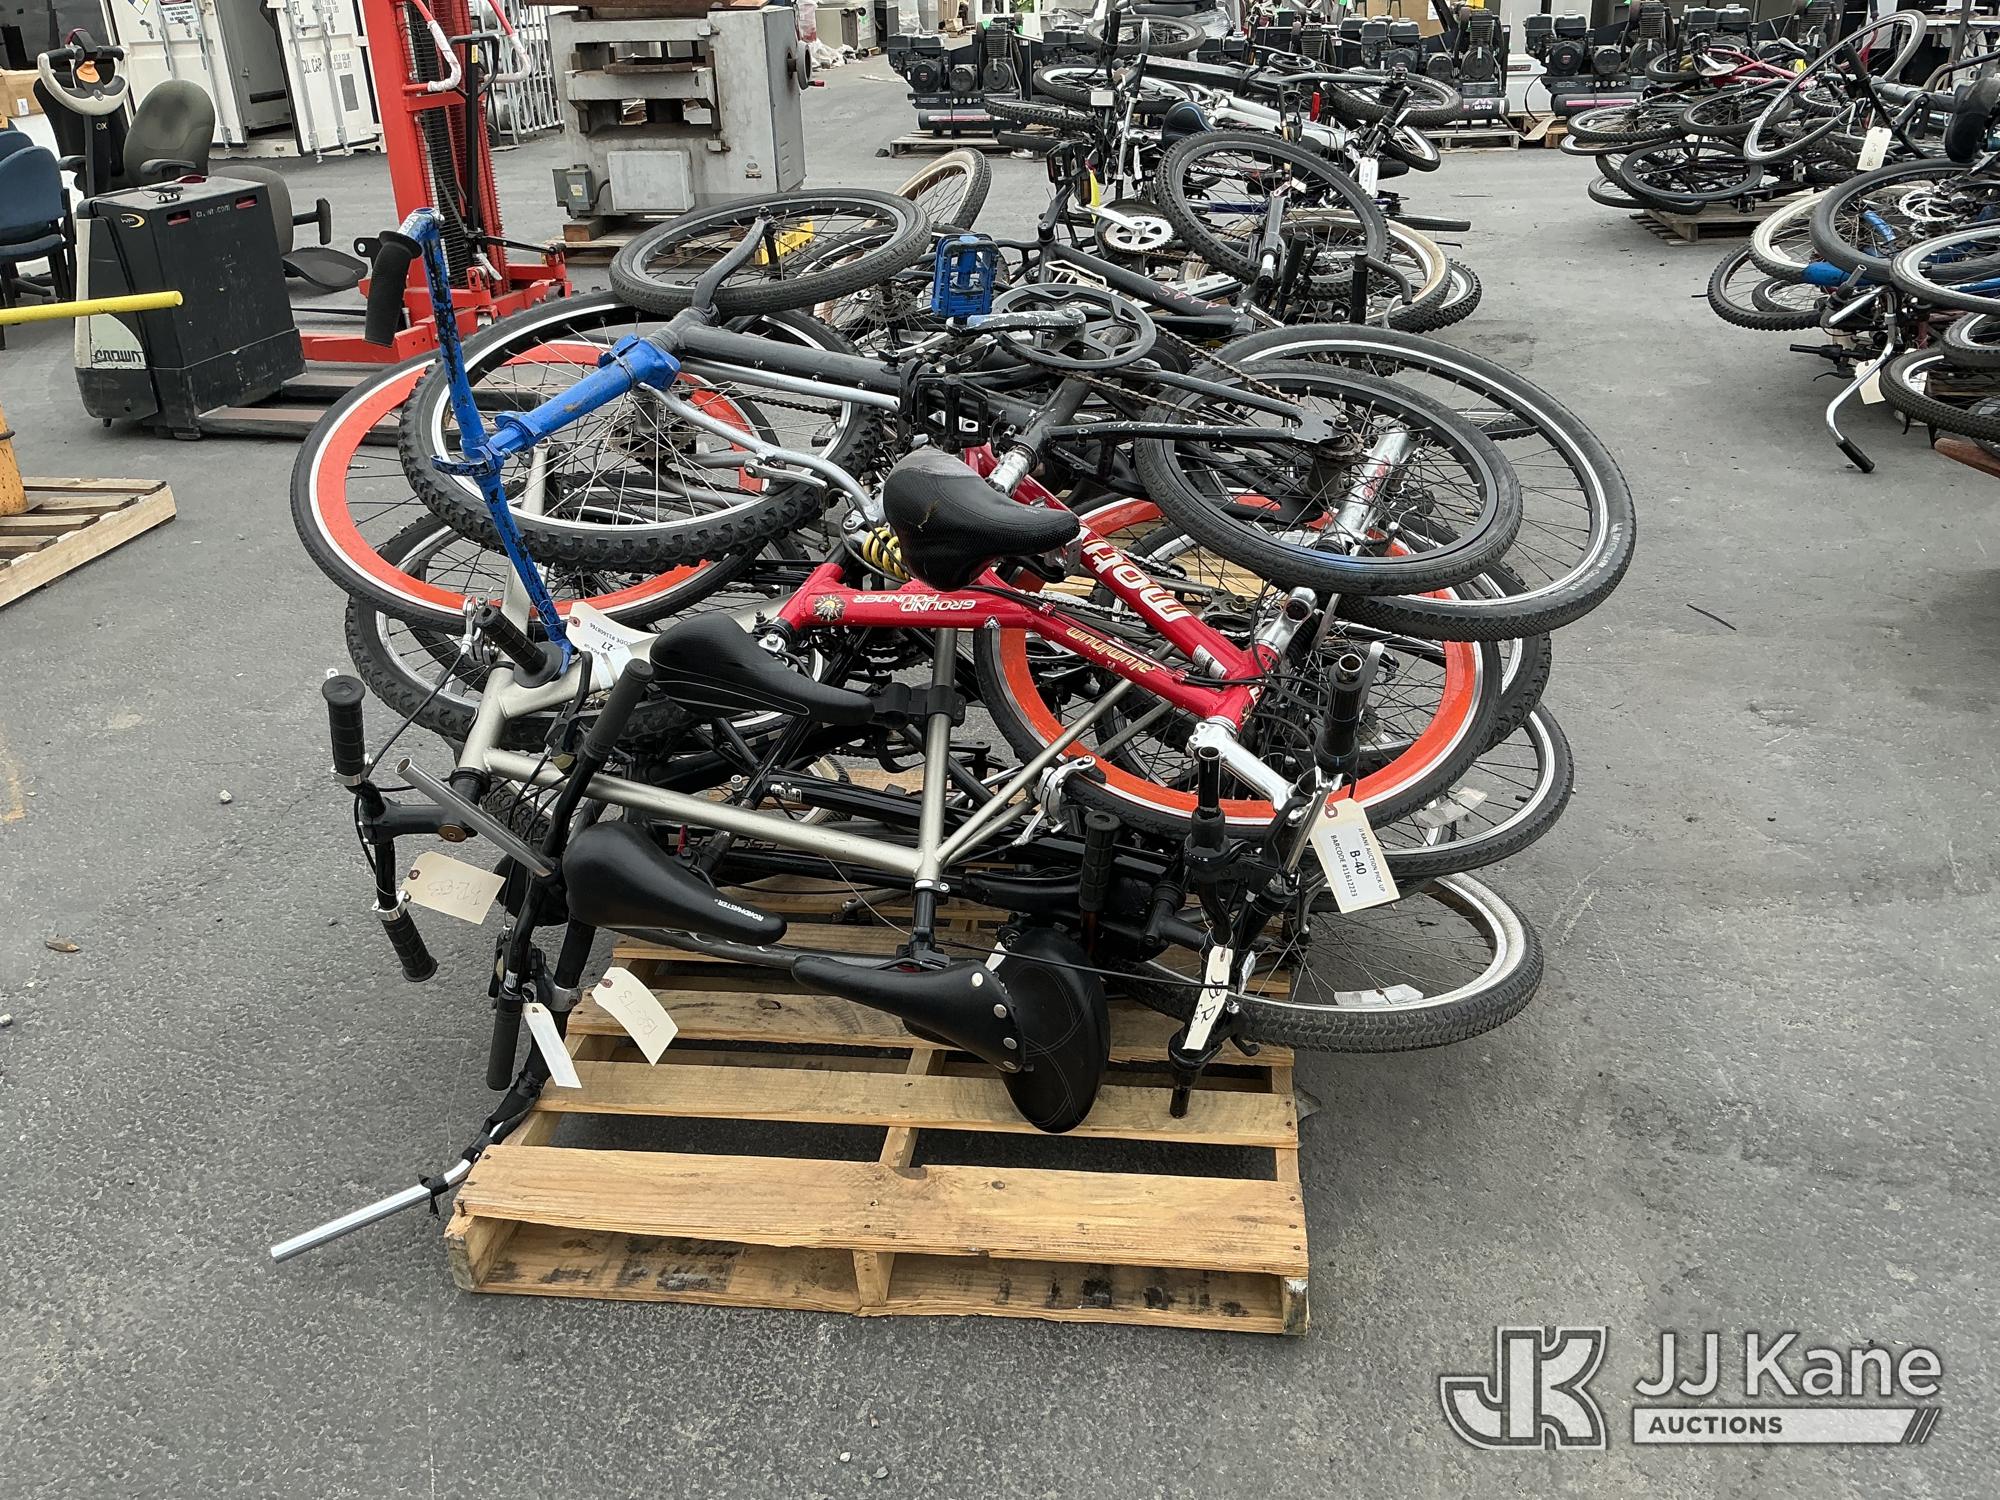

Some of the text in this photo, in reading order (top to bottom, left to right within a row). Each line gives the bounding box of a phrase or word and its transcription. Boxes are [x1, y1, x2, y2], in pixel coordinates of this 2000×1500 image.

[853, 594, 940, 604] POUNDER
[900, 599, 977, 612] GROUND
[1066, 627, 1155, 674] aluminum
[1330, 835, 1346, 863] BARCODE
[1349, 850, 1367, 875] B-40
